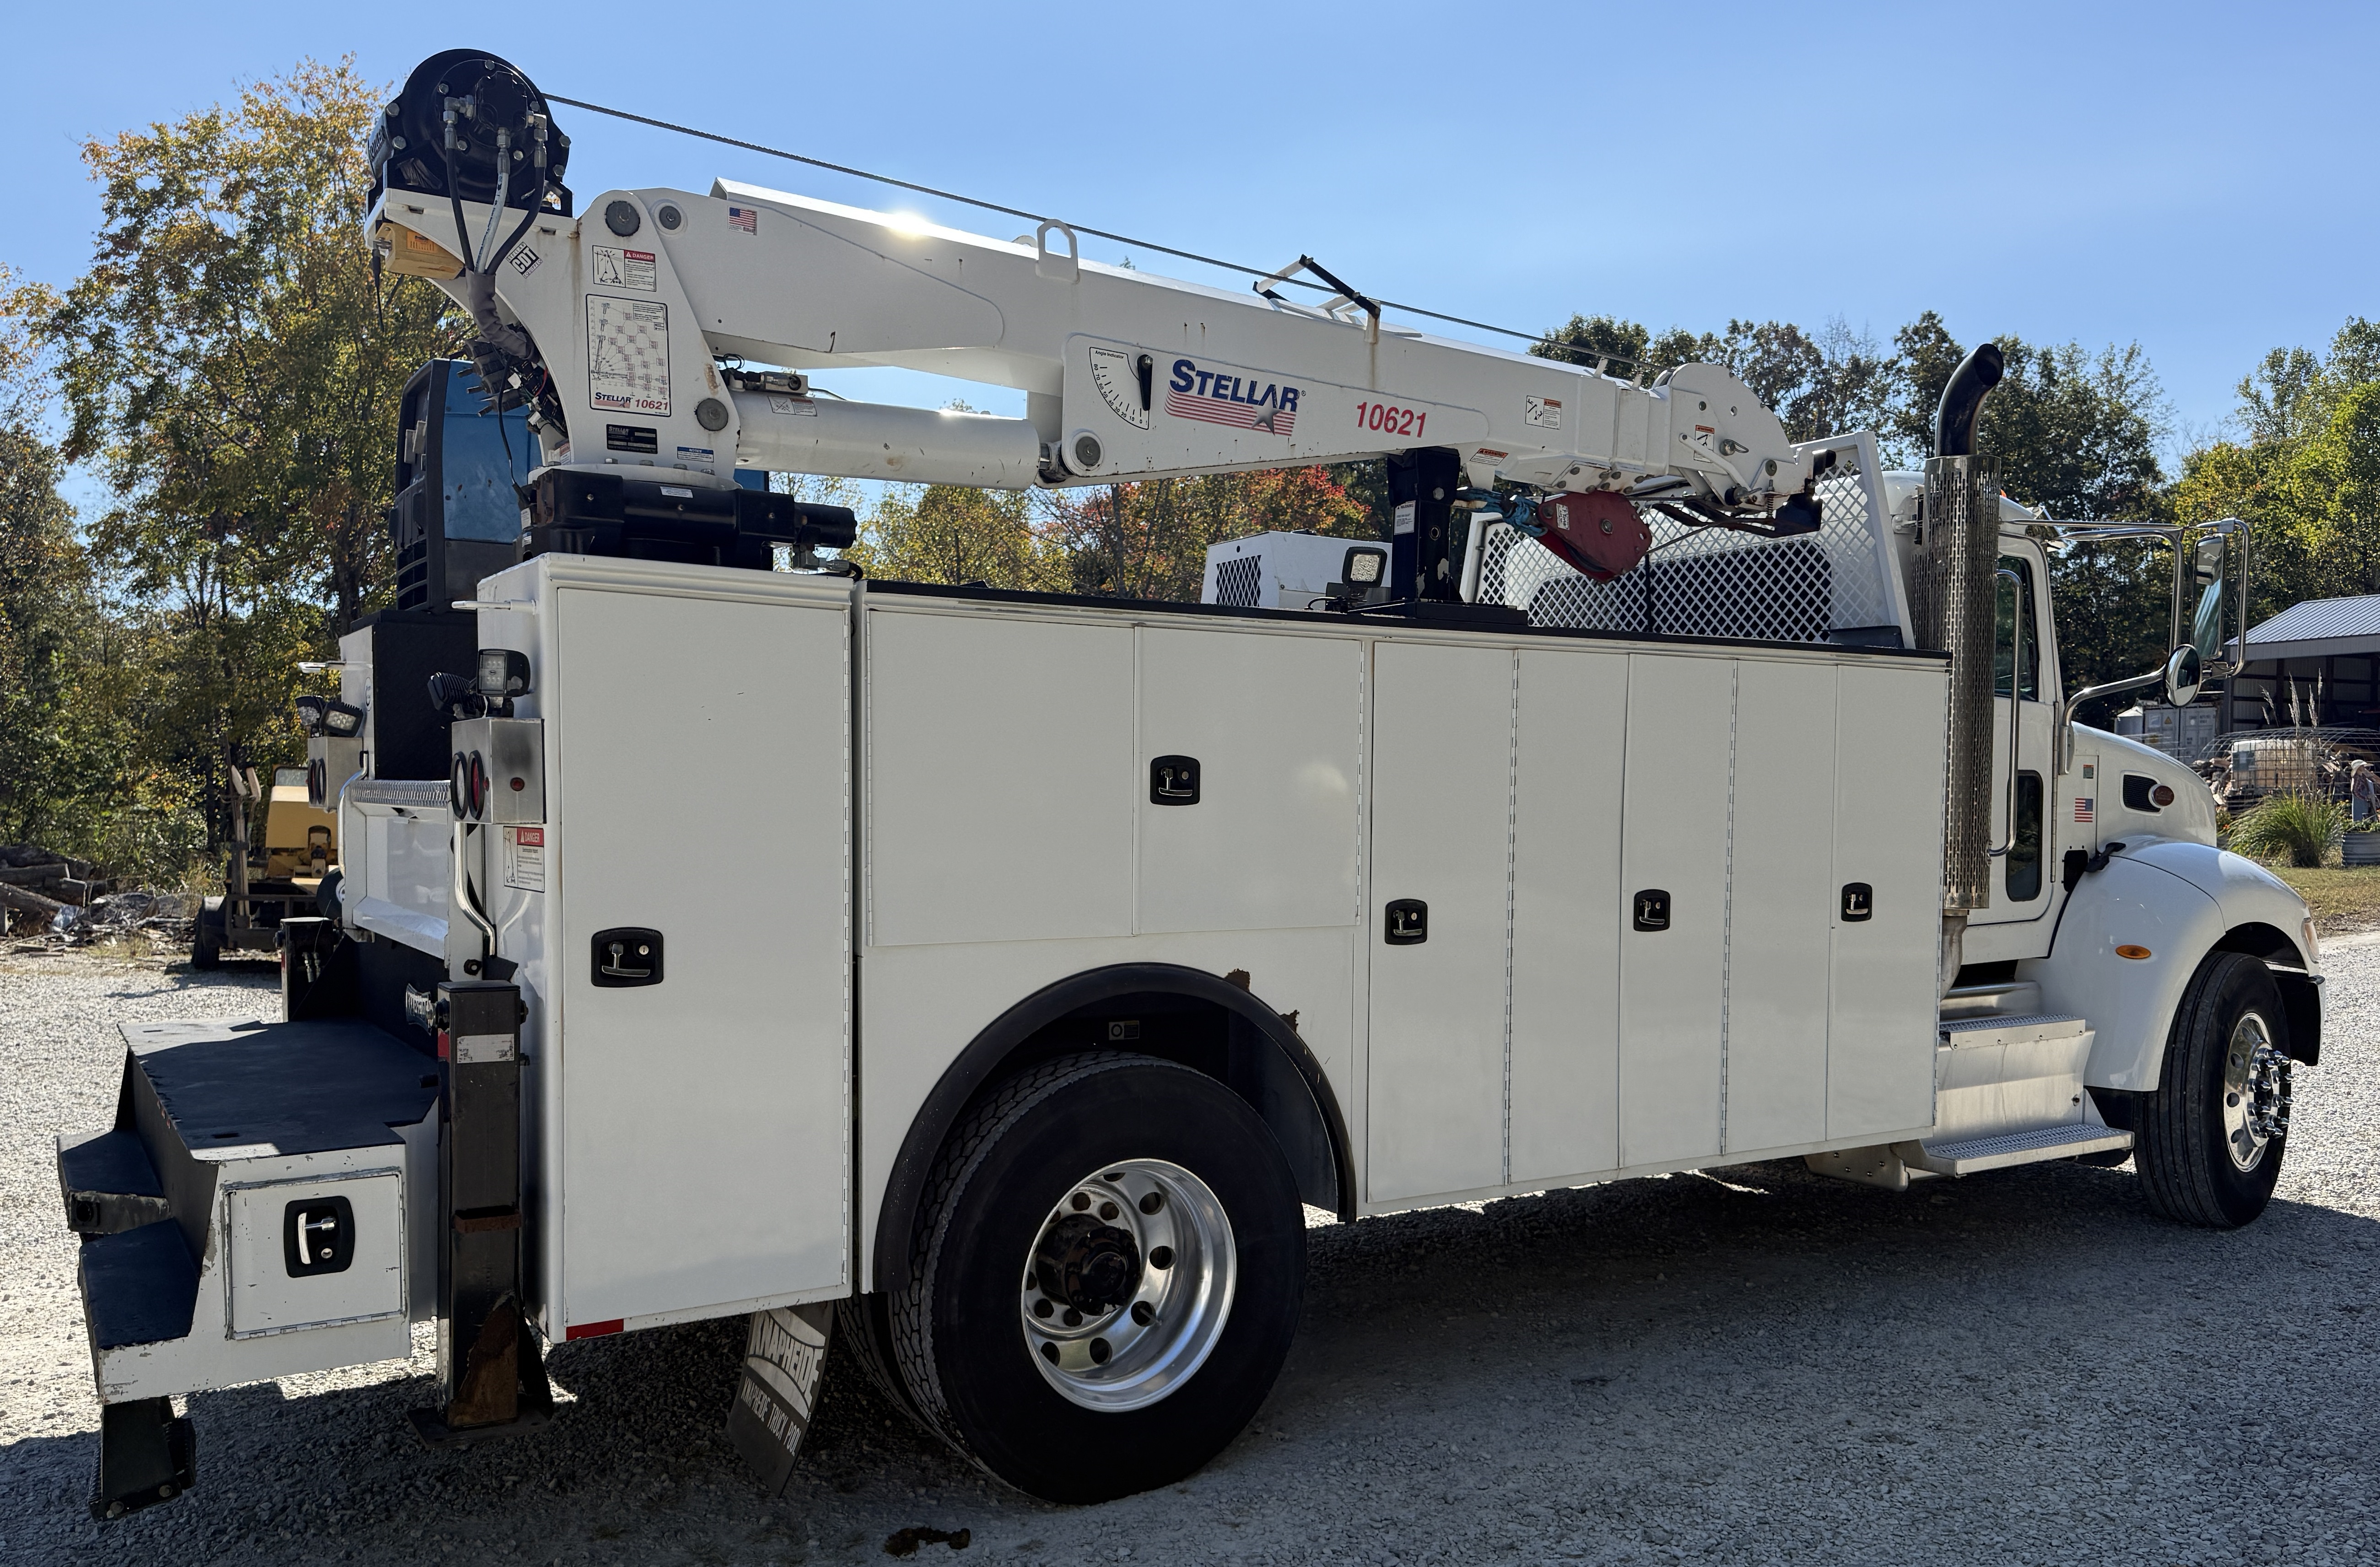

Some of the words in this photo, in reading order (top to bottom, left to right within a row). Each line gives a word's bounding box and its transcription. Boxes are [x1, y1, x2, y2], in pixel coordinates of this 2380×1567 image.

[507, 243, 525, 261] STELLAR
[512, 247, 536, 273] CDT
[595, 392, 631, 403] STELLAR
[635, 399, 668, 410] 10621
[1357, 402, 1426, 438] 10621
[525, 832, 540, 842] DANGER
[749, 1310, 824, 1410] KNAPHEIDE
[741, 1376, 771, 1422] KNAPHEIDE
[767, 1403, 789, 1441] TRUCK
[783, 1421, 802, 1456] POOL
